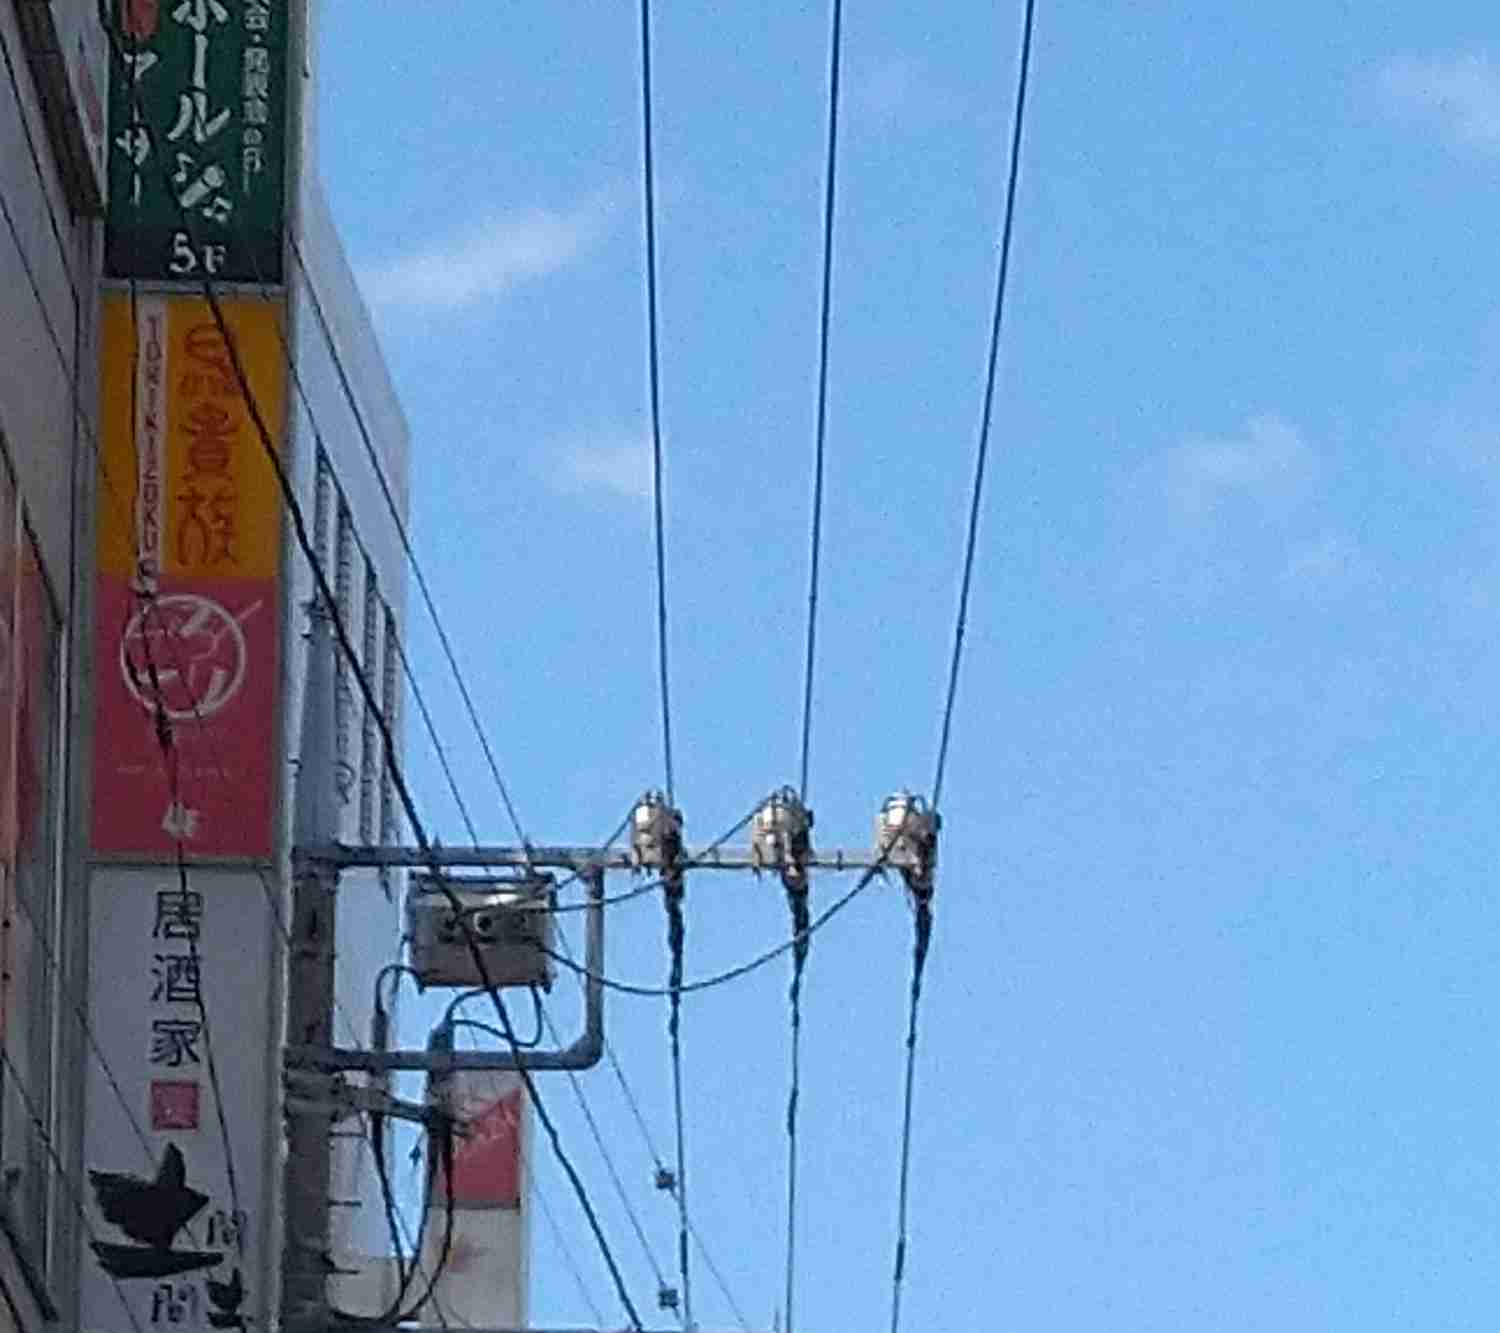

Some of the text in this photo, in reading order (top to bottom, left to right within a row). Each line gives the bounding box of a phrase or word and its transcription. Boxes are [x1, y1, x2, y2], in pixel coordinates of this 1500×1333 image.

[168, 231, 226, 274] 5F
[151, 889, 202, 1067] 居酒家
